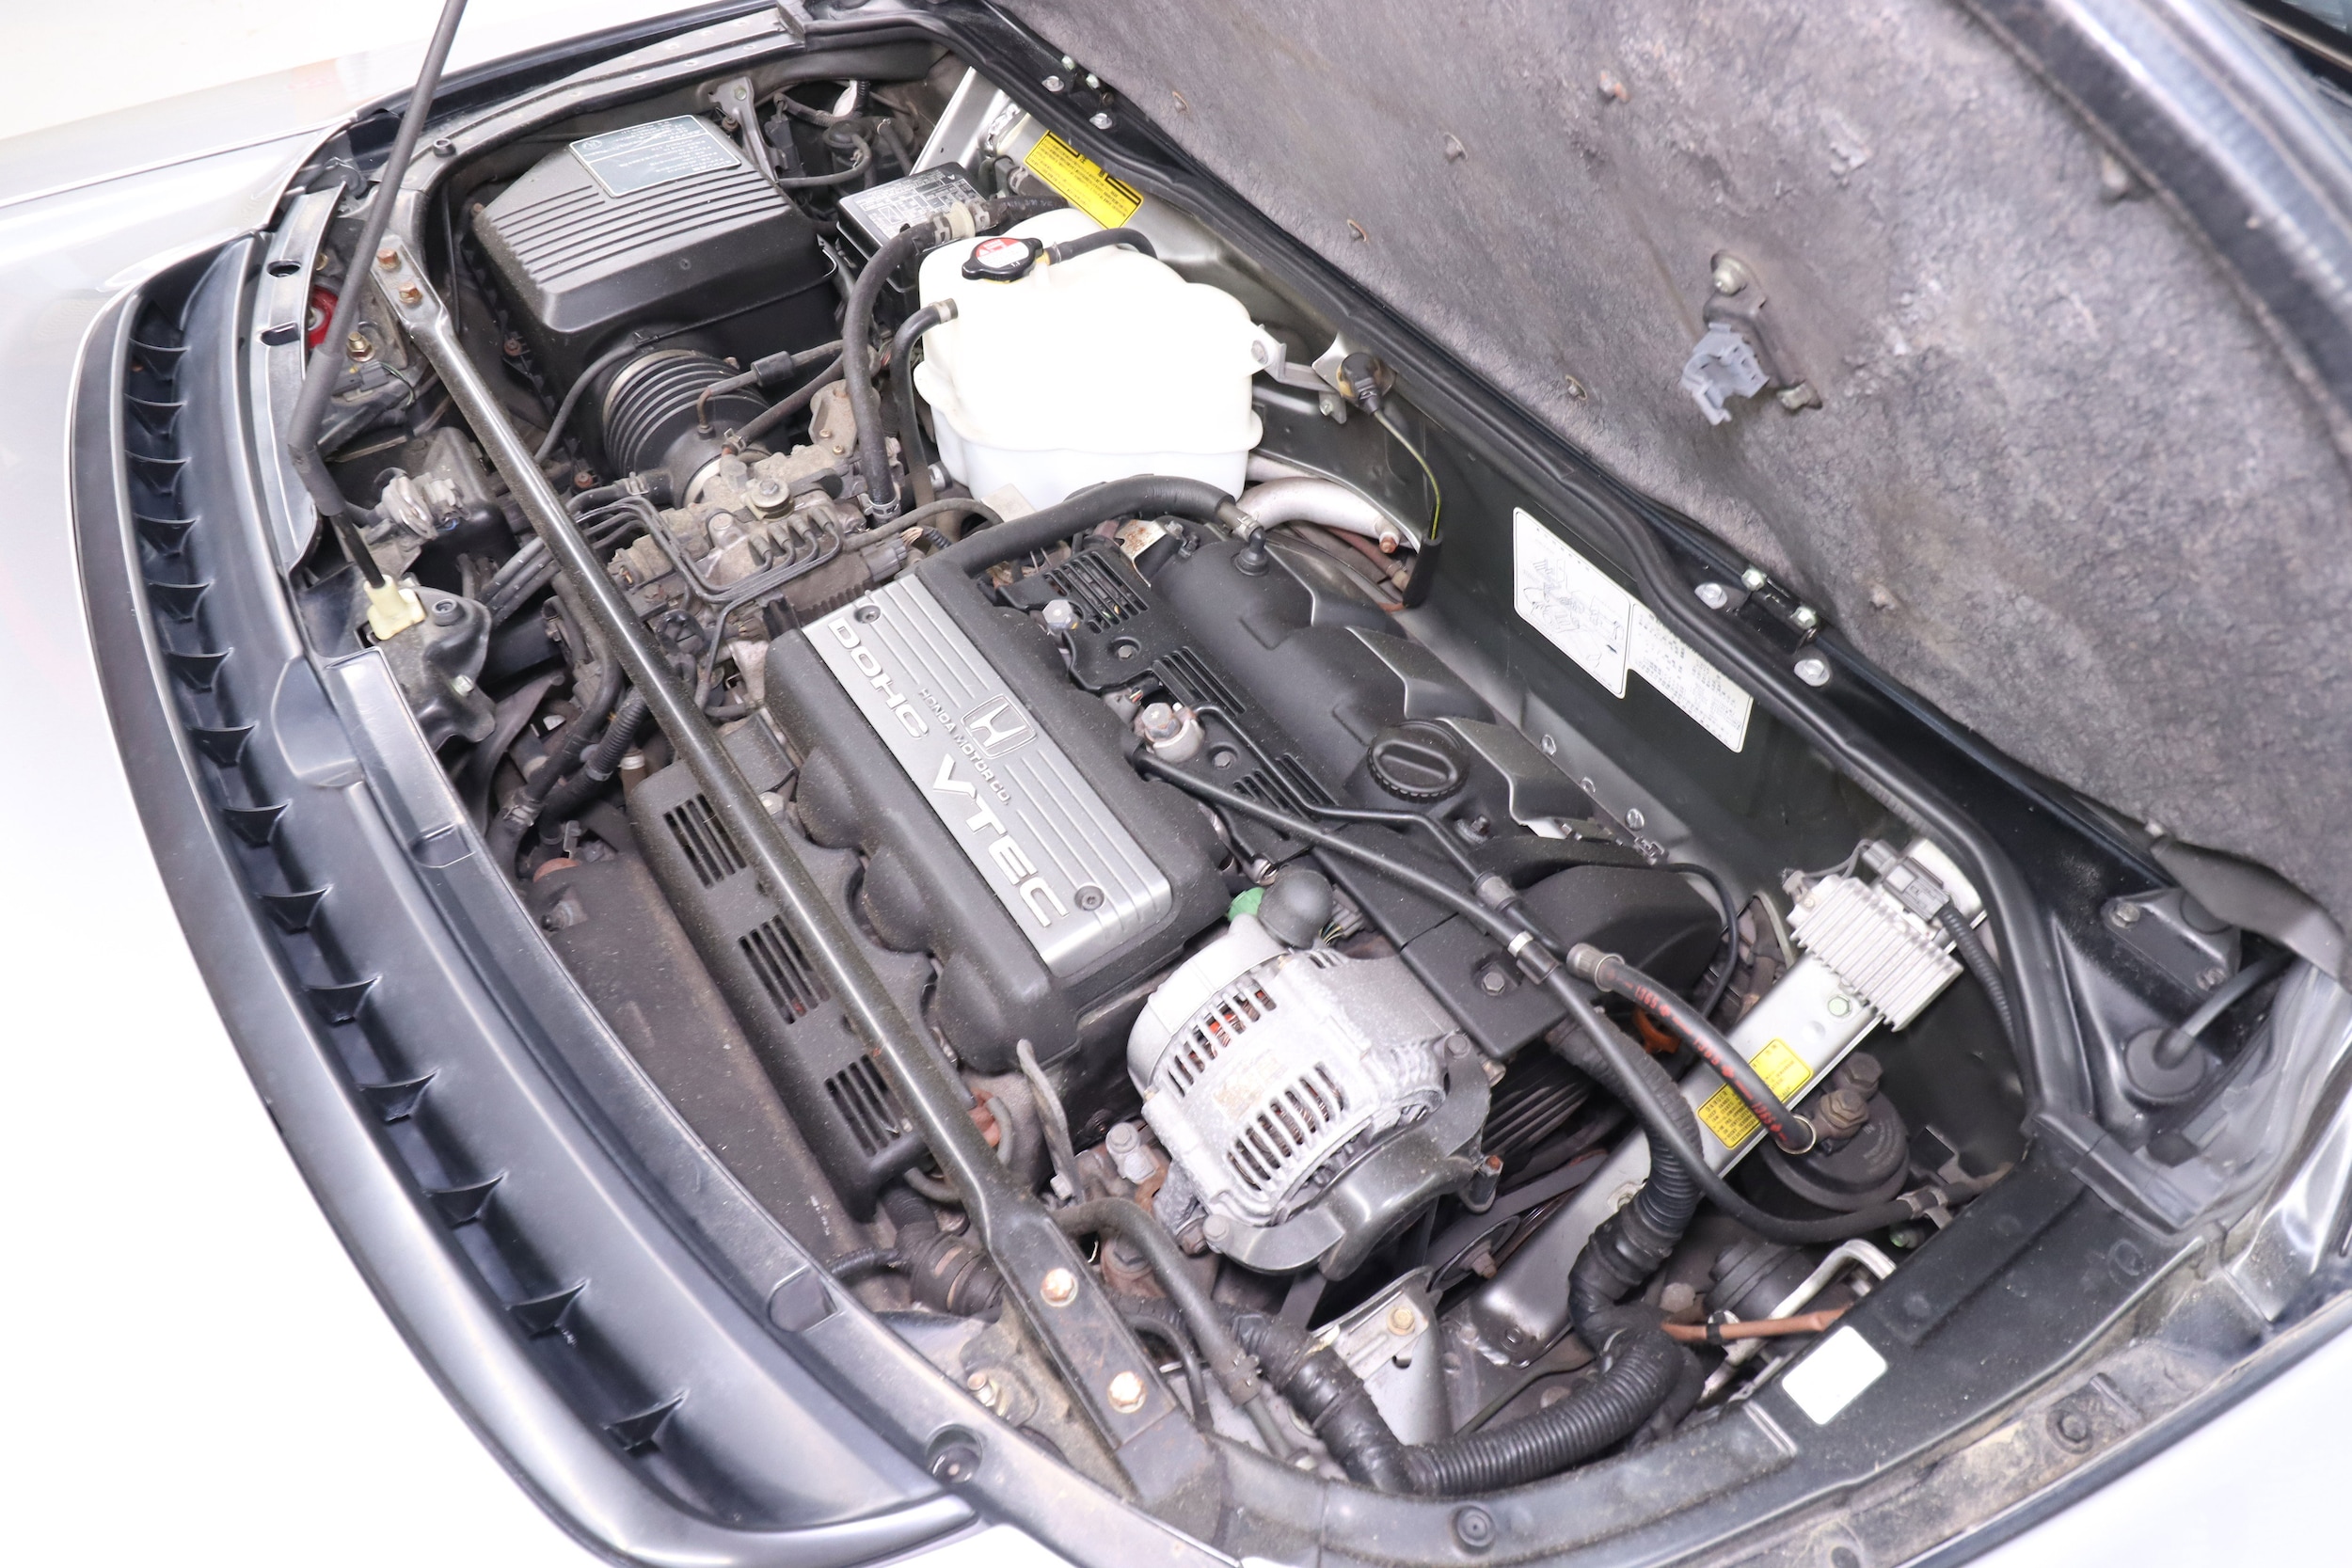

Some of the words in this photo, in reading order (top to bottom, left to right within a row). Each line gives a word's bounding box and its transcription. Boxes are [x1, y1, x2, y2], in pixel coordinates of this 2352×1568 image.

[828, 617, 929, 738] DOHC
[918, 688, 957, 735] HONDA
[953, 734, 995, 782] MOTOR
[932, 752, 1069, 927] VTEC
